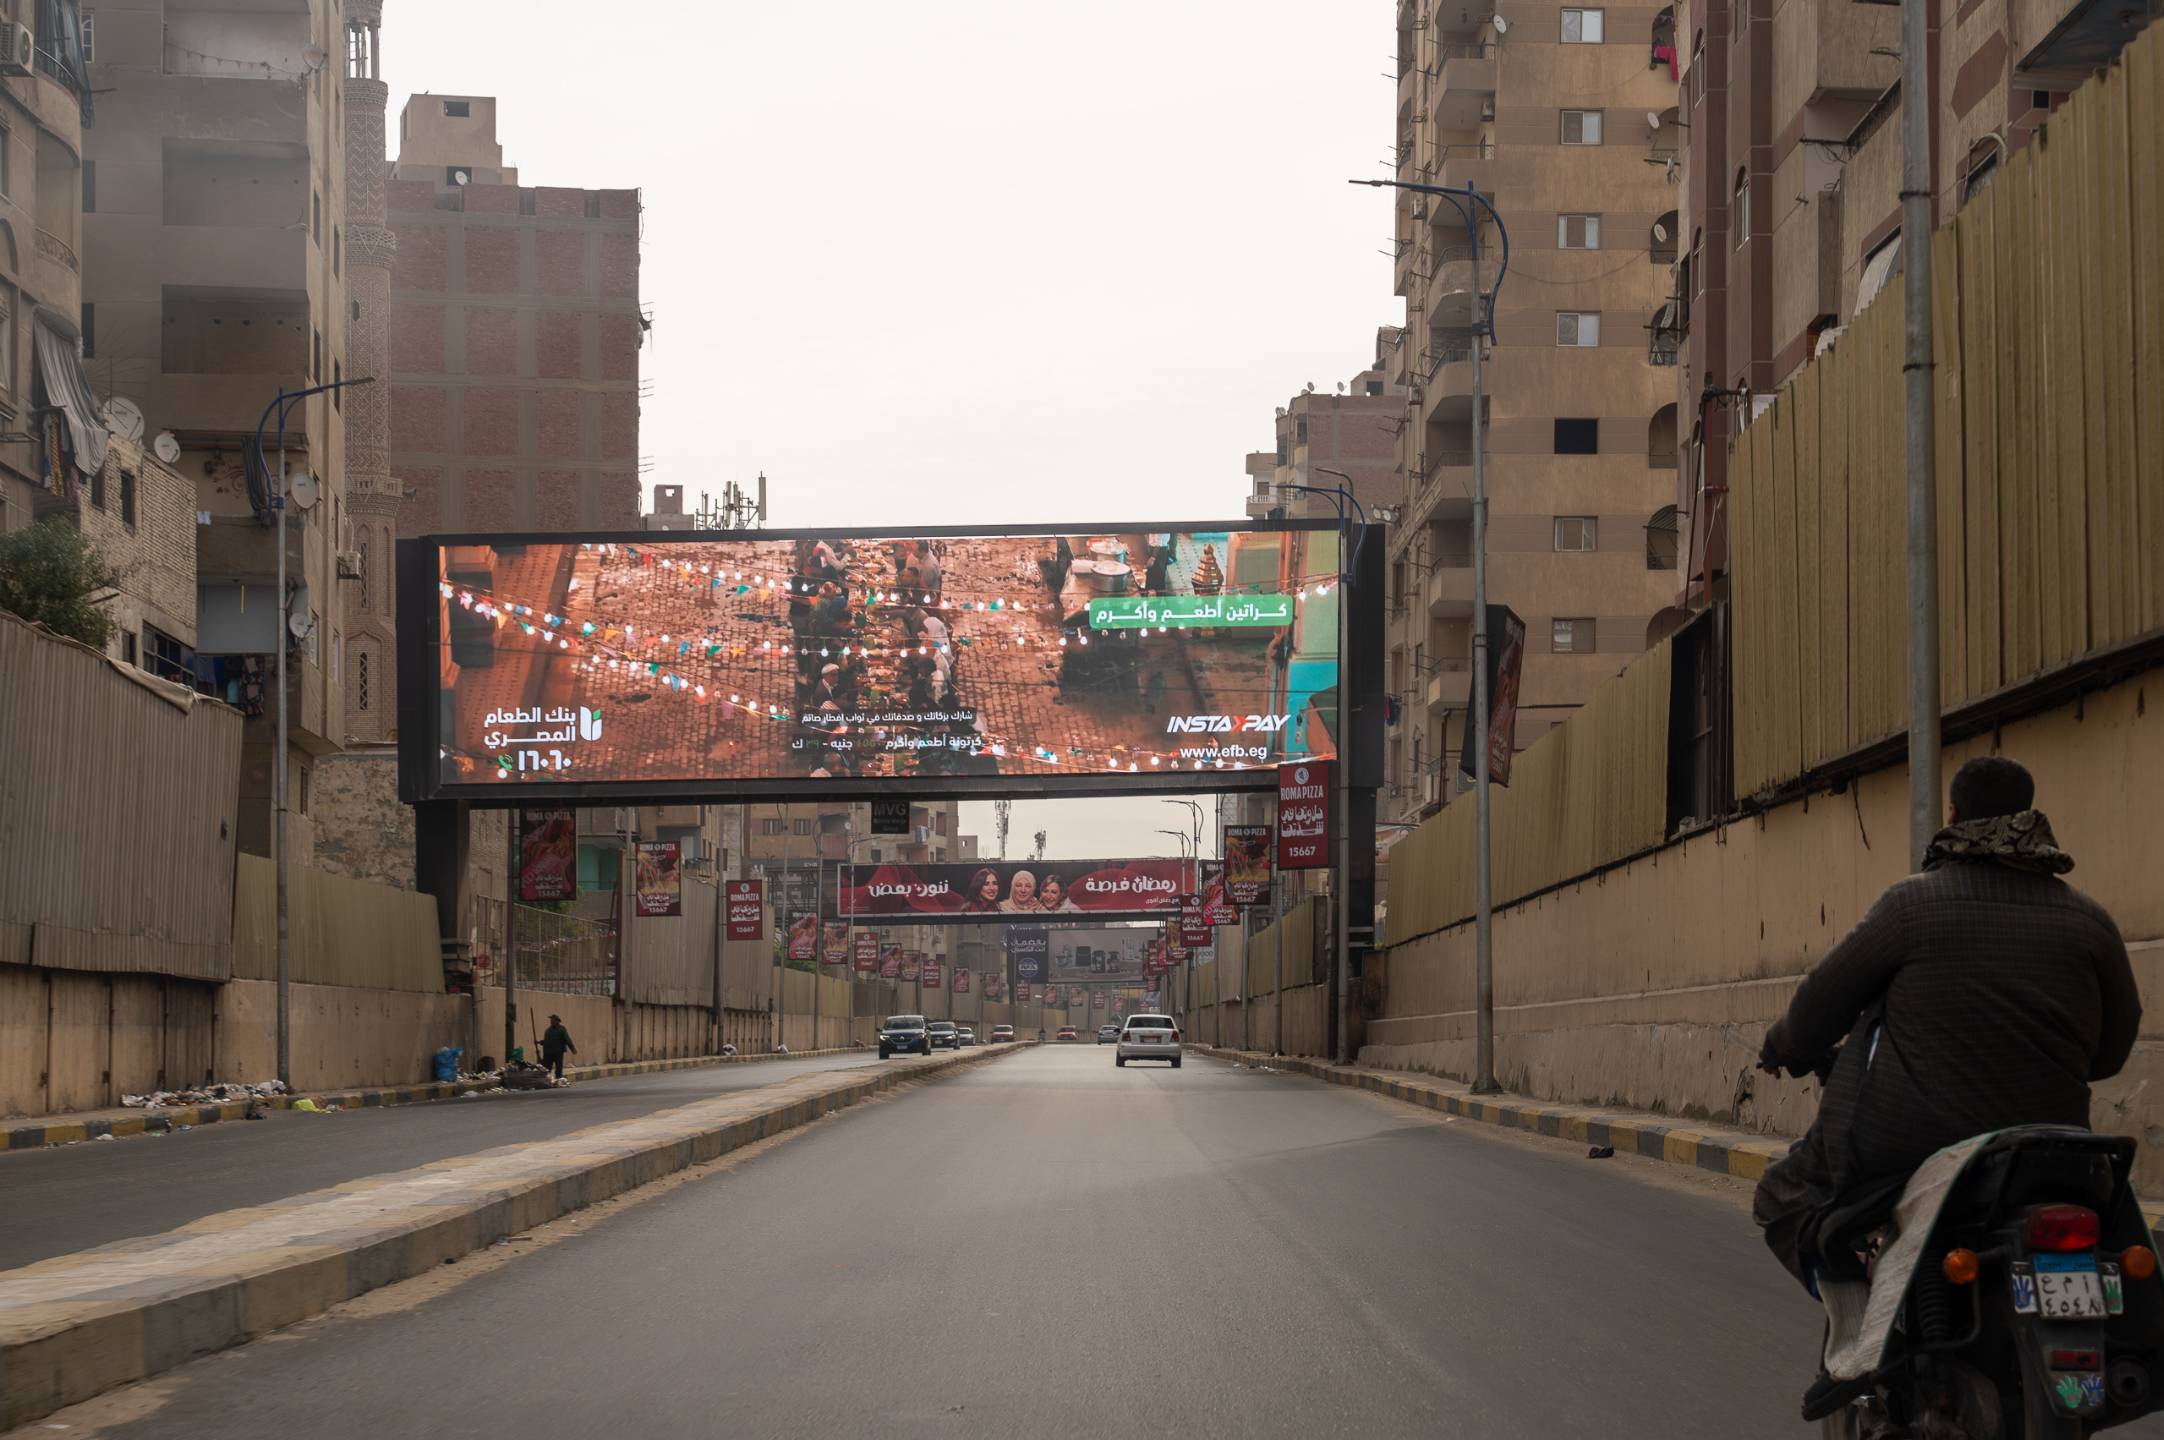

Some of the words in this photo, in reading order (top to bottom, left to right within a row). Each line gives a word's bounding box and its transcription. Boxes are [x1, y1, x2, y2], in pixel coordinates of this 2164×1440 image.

[1096, 602, 1157, 623] وأكرم
[1161, 599, 1222, 623] أطعم
[1226, 602, 1287, 621] كراتين
[484, 706, 541, 728] الطعام
[545, 706, 576, 725] بنك
[866, 713, 880, 724] في
[882, 712, 914, 721] صدقاتك
[916, 714, 922, 722] و
[950, 710, 972, 721] شارك
[484, 725, 576, 749] المصري
[792, 738, 803, 748] ك
[830, 738, 853, 750] جنيه
[885, 734, 914, 750] وأكرم
[917, 733, 946, 749] أطعم
[949, 735, 981, 748] كرتونة
[1180, 745, 1267, 759] www.efb.eg
[518, 749, 572, 771] ١٦٠٦٠
[1280, 787, 1302, 800] ROMA
[1302, 785, 1324, 798] PIZZA
[874, 803, 906, 816] MVG
[1289, 847, 1316, 857] 15667
[868, 882, 912, 897] بعض
[1085, 877, 1130, 893] فرصة
[1132, 875, 1176, 893] رمضان
